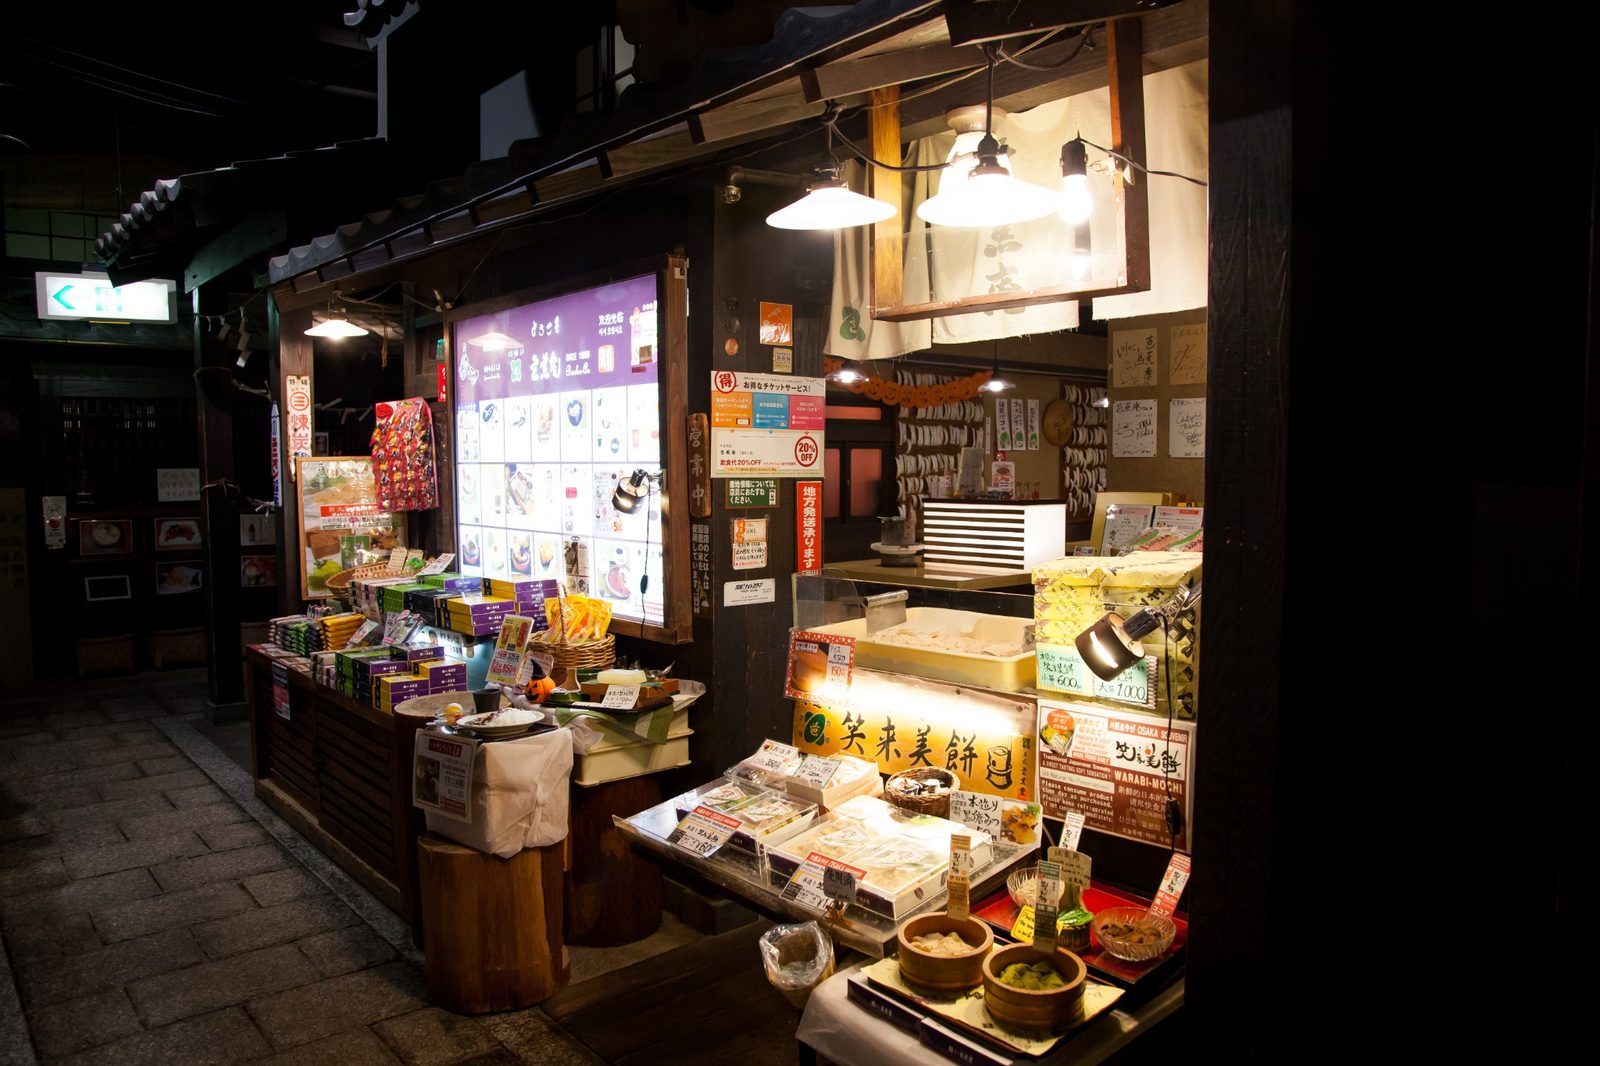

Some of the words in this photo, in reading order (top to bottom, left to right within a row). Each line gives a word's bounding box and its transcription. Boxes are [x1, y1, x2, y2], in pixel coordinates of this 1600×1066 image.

[531, 315, 560, 337] ようこそ
[720, 373, 732, 388] 得
[292, 414, 310, 450] 煉炭
[798, 442, 815, 453] 20%
[800, 453, 813, 462] OFF
[690, 428, 704, 507] 営業中
[803, 486, 816, 568] 地方発送承ります
[1137, 726, 1158, 737] OSAKA
[840, 711, 978, 778] 笑来美餅
[1043, 754, 1067, 762] Traditional
[1069, 759, 1091, 768] Japanese
[1093, 764, 1110, 772] Sweets
[1059, 764, 1075, 772] TASTING
[1041, 780, 1061, 789] Please
[1063, 786, 1087, 795] consume
[1089, 792, 1113, 802] product
[1114, 770, 1183, 793] WARABI-MOCHI
[968, 794, 998, 812] 本造り
[1042, 794, 1060, 803] Please
[1062, 799, 1075, 807] keep
[1077, 803, 1114, 816] refrigerated
[1080, 796, 1112, 808] purchased.
